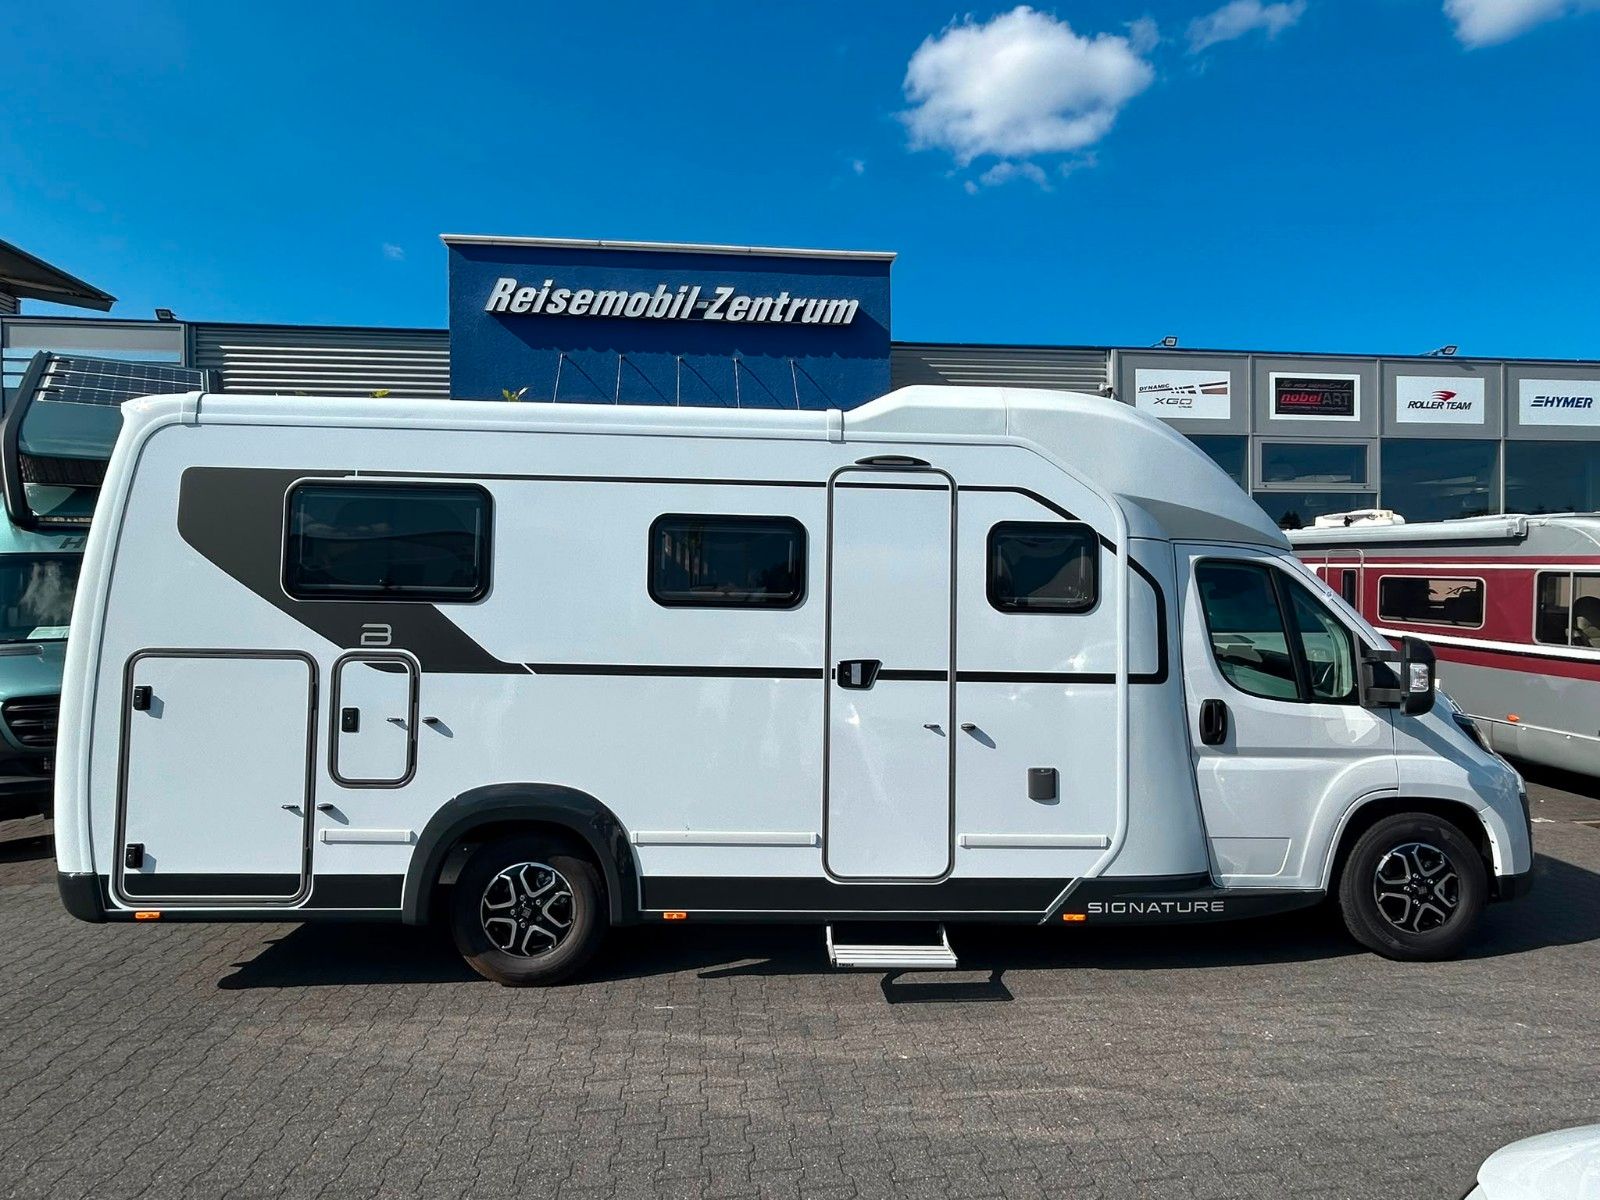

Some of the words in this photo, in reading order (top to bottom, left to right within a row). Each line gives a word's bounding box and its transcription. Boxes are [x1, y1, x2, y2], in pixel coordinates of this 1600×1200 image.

[485, 277, 859, 325] Reisemobil-Zentrum
[1139, 383, 1170, 391] DYNAMIC
[1153, 397, 1193, 405] XGO
[1407, 400, 1444, 410] ROLLER
[1446, 401, 1472, 410] TEAM
[1087, 901, 1225, 914] SIGNATURE
